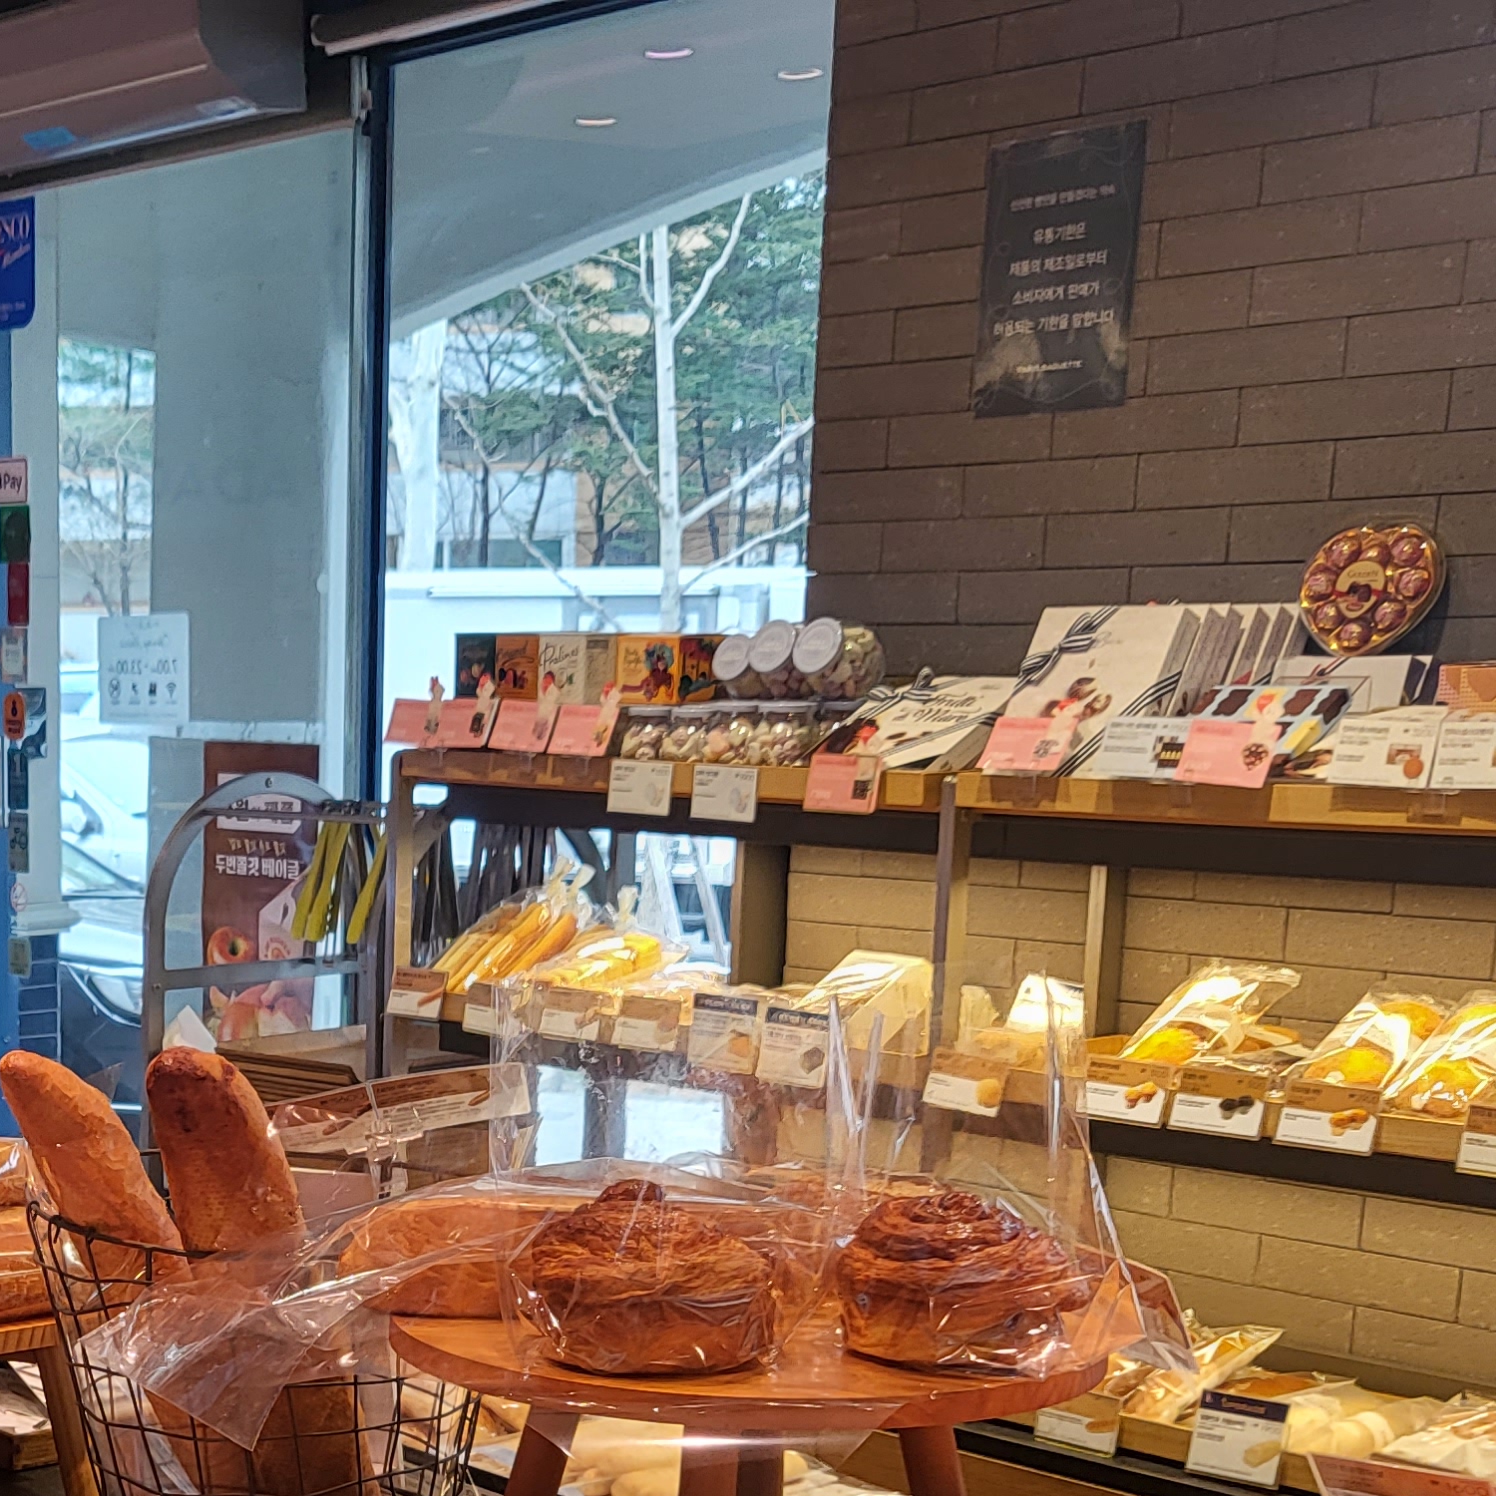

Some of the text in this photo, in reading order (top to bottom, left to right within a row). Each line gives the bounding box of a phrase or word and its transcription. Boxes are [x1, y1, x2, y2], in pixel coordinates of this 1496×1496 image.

[1033, 221, 1087, 245] 유통기한은
[4, 473, 23, 494] Pay
[261, 858, 302, 880] 베이글
